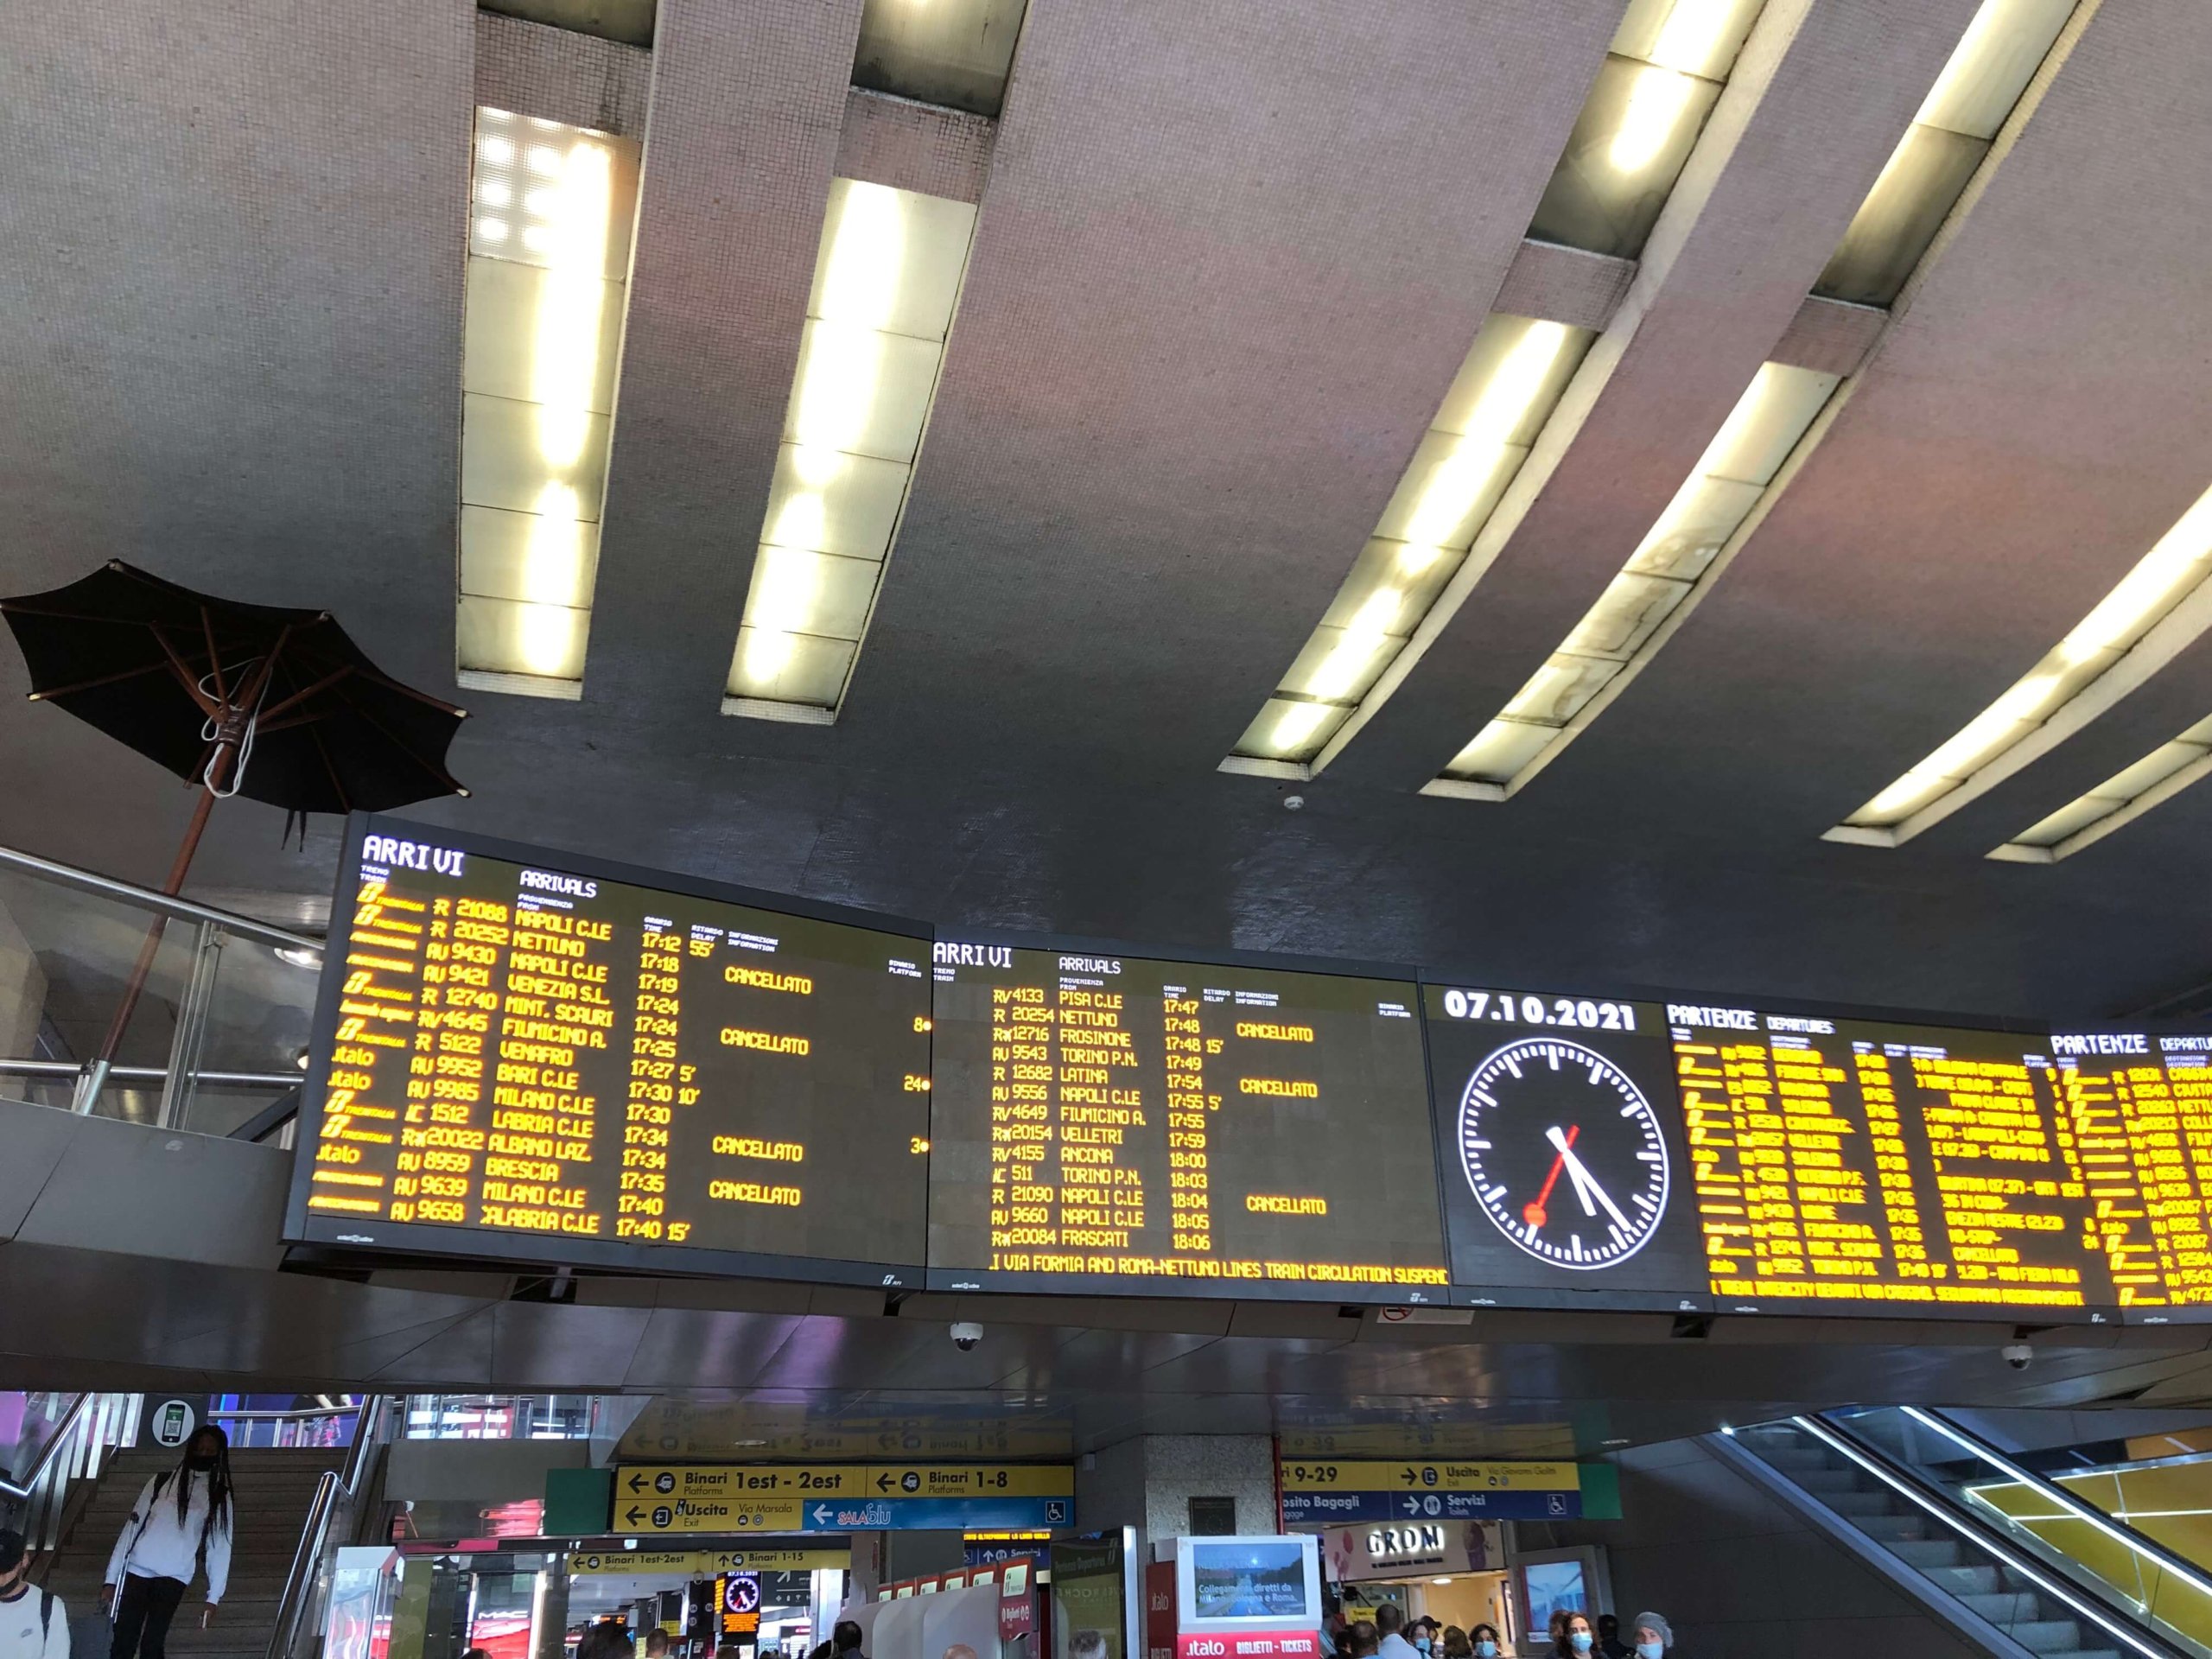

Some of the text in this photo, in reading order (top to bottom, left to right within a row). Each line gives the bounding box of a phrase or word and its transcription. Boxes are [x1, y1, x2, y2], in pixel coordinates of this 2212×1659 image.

[362, 835, 465, 877] ARRIVI
[519, 870, 597, 899] ARRIVALS
[514, 909, 574, 935] NAPOLI
[642, 931, 682, 953] 17:12
[451, 941, 497, 965] 9430
[509, 951, 569, 977] NAPOLI
[638, 973, 678, 994] 17:19
[512, 930, 586, 957] NETTUNO
[640, 952, 680, 973] 17:18
[724, 966, 812, 995] CANCELLATO
[932, 942, 1012, 969] ARRIVI
[1058, 956, 1122, 975] ARRIVALS
[448, 963, 490, 988] 9421
[636, 994, 680, 1015] 17:24
[1011, 988, 1044, 1004] 4133
[1058, 990, 1091, 1007] PISA
[1164, 999, 1199, 1015] 17:47
[445, 987, 809, 1056] 12740 MINT. 17:24 CANCELLATO
[1012, 1006, 1313, 1042] 20254 NETTUNO 17:48 CANCELLATO
[1444, 989, 1637, 1032] 07.10.2021
[1667, 1004, 1759, 1031] PARTENZE
[440, 1009, 489, 1033] 4645
[632, 1037, 677, 1058] 17:25
[1011, 1025, 1202, 1052] 12716 FROSINONE 17:48
[2050, 1033, 2151, 1055] PARTENZE
[438, 1031, 676, 1080] 5122 VENAFRO 17:27
[1012, 1044, 1047, 1061] 9543
[1059, 1047, 1109, 1065] TORINO
[1166, 1054, 1203, 1071] 17:49
[435, 1054, 673, 1103] 9952 BARI 17:30
[1012, 1064, 1319, 1098] 12682 LATINA 17:54 CANCELLATO
[433, 1077, 480, 1102] 9985
[493, 1086, 556, 1111] MILANO
[626, 1103, 671, 1125] 17:30
[1012, 1083, 1048, 1101] 9556
[1060, 1086, 1108, 1104] NAPOLI
[1167, 1092, 1205, 1109] 17:55
[1012, 1103, 1048, 1121] 4649
[1060, 1105, 1130, 1125] FIUMICINO
[1168, 1112, 1205, 1129] 17:55
[429, 1102, 470, 1125] 1512
[624, 1125, 669, 1147] 17:34
[712, 1135, 804, 1162] CANCELLATO
[1011, 1123, 1206, 1149] 20154 VELLETRI 17:59
[423, 1125, 667, 1170] 20022 ALBANO 17:34
[1011, 1144, 1207, 1169] 4155 ANCONA 18:00
[423, 1150, 801, 1206] 8959 BRESCIA 17:35 CANCELLATO
[1011, 1164, 1033, 1181] 511
[1061, 1166, 1112, 1185] TORINO
[1170, 1172, 1208, 1190] 18:03
[420, 1174, 664, 1216] 9639 MILANO 17:40
[1011, 1185, 1054, 1203] 21090
[1061, 1187, 1110, 1205] NAPOLI
[1171, 1192, 1209, 1210] 18:04
[1246, 1195, 1327, 1215] CANCELLATO
[416, 1198, 662, 1239] 9658 17:40
[1011, 1205, 1049, 1224] 9660
[1061, 1207, 1110, 1226] NAPOLI
[1172, 1212, 1210, 1230] 18:05
[1011, 1227, 1211, 1251] 20084 FRASCATI 18:06
[1003, 1254, 1030, 1271] VIA
[1033, 1254, 1084, 1273] FORMIA
[1087, 1256, 1116, 1274] AND
[1222, 1261, 1262, 1279] LINES
[1264, 1262, 1306, 1280] TRAIN
[1306, 1263, 1393, 1283] CIRCULATION
[685, 1472, 728, 1484] Binari
[798, 1471, 842, 1489] 2est
[929, 1471, 1008, 1488] Binari 1-8
[1294, 1466, 1338, 1483] 9-29
[1446, 1466, 1480, 1478] Uscita
[683, 1486, 723, 1496] Platforms
[928, 1485, 965, 1495] Platforms
[1313, 1495, 1360, 1510] Bagagli
[1446, 1495, 1486, 1506] Servizi
[685, 1504, 728, 1516] Uscita
[739, 1503, 792, 1514] Via Marsala
[683, 1518, 699, 1528] Exit
[1367, 1526, 1443, 1555] GROM
[605, 1554, 684, 1565] Binari 1est-2est
[748, 1553, 804, 1562] Binari 1-15
[1254, 1583, 1293, 1592] diretti da
[1236, 1639, 1312, 1655] BIGLIETTI TICKETS
